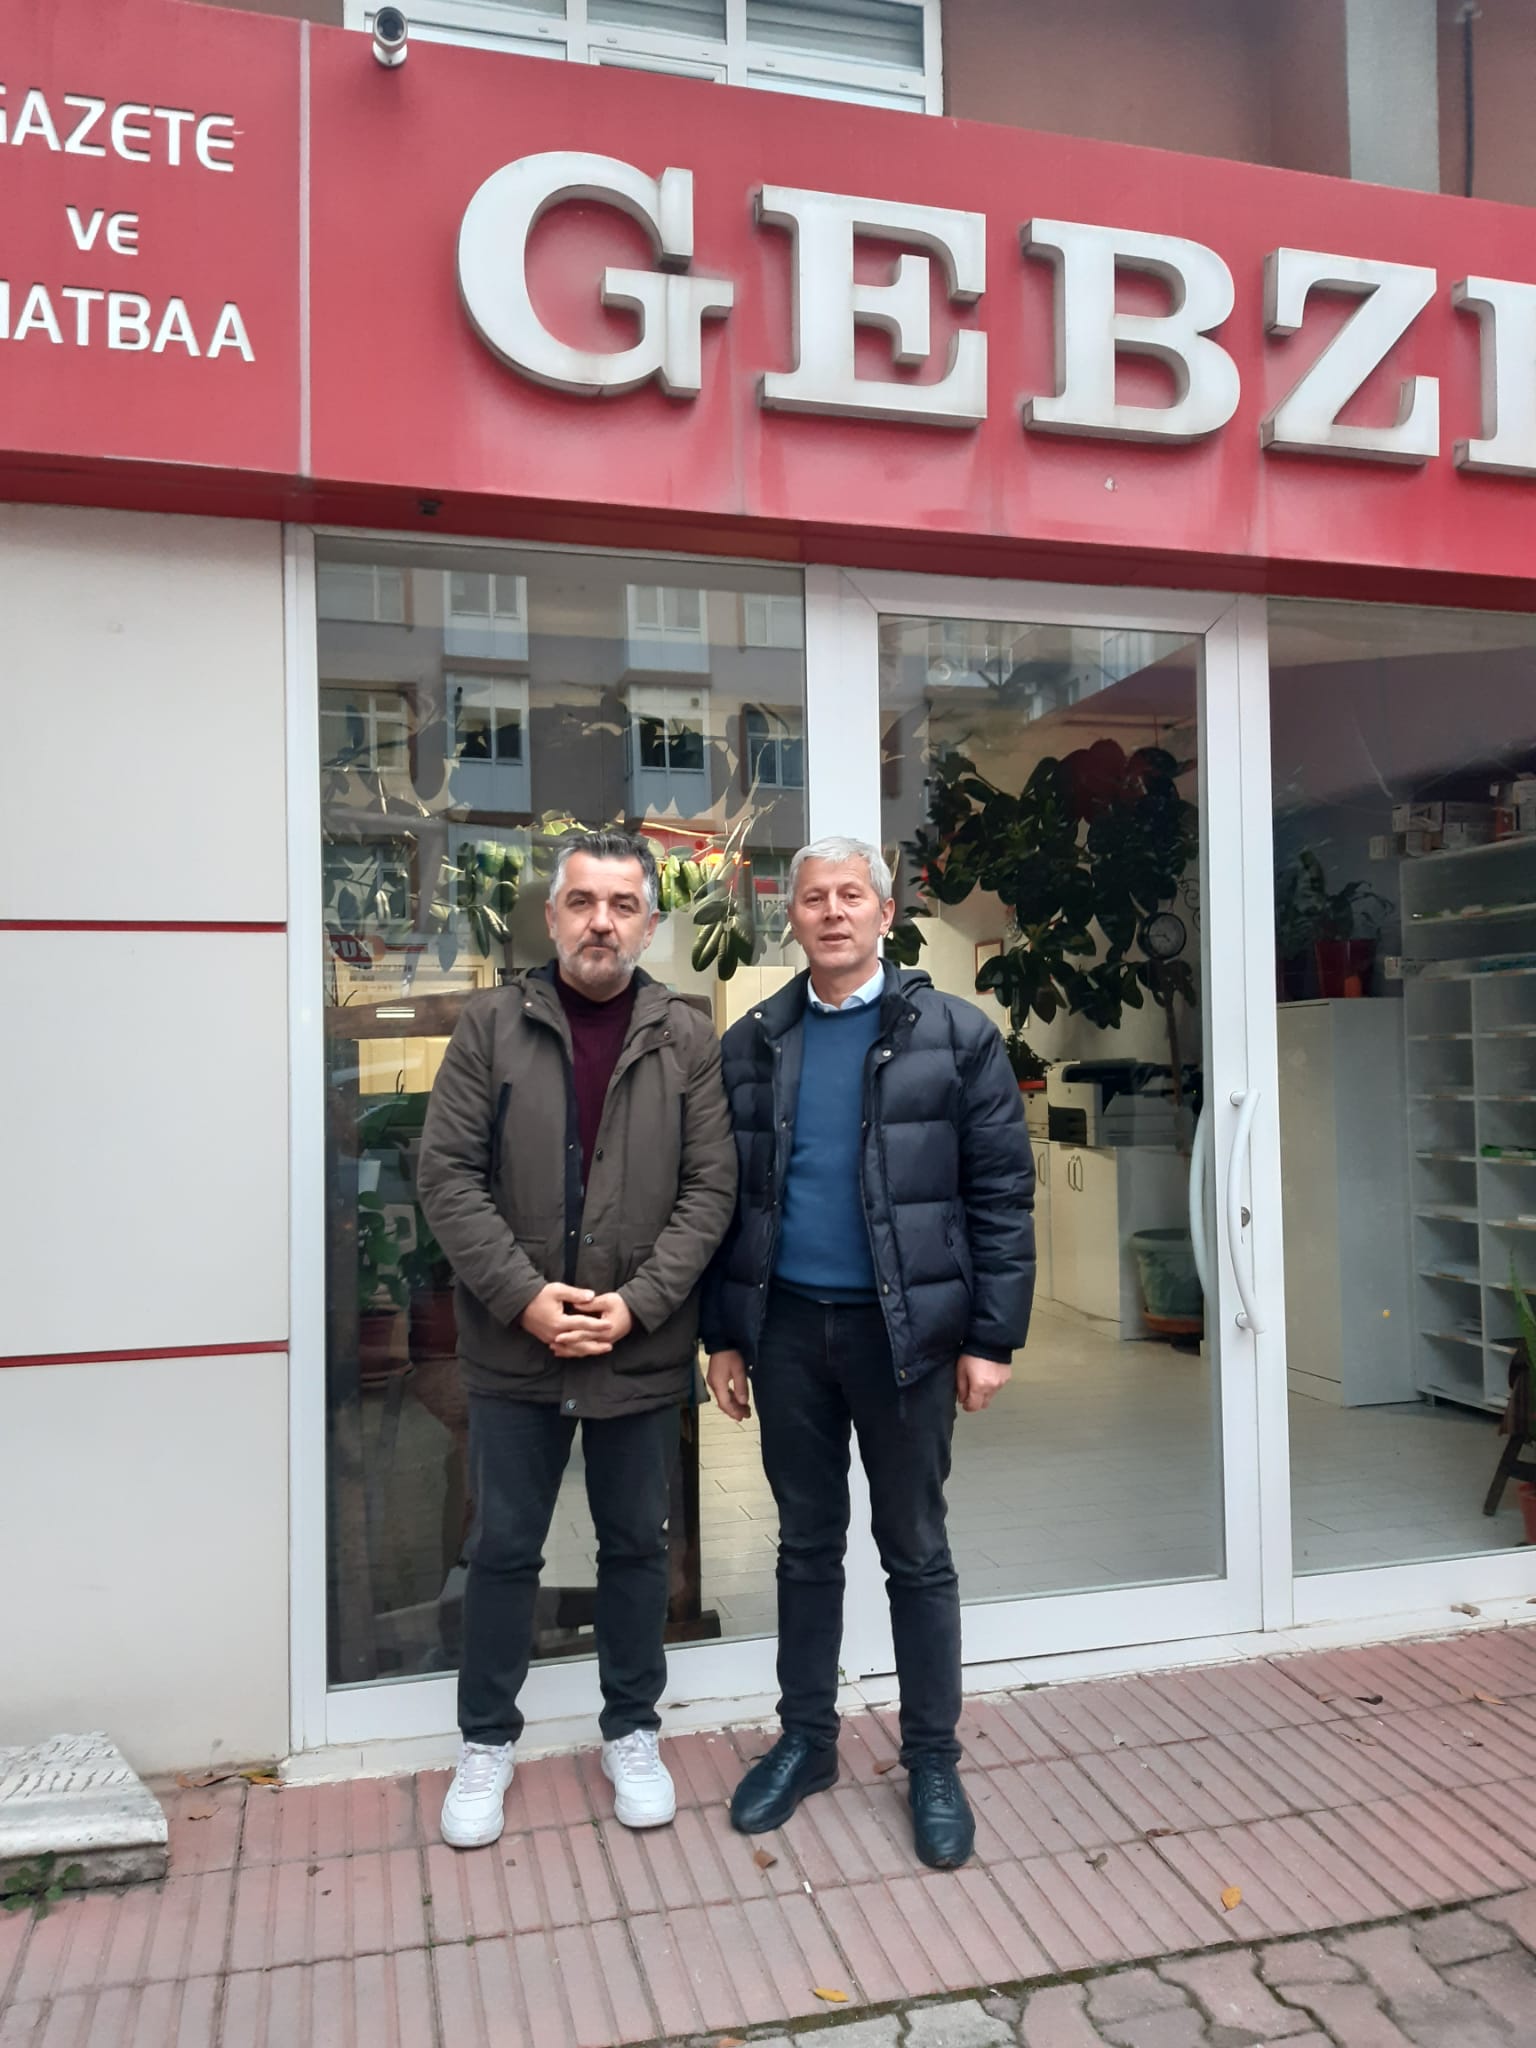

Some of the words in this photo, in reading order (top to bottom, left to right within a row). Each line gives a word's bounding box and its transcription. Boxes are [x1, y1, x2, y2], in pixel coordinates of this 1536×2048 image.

[0, 83, 235, 172] AZETE
[66, 205, 139, 255] VE
[0, 279, 255, 362] ATBAA
